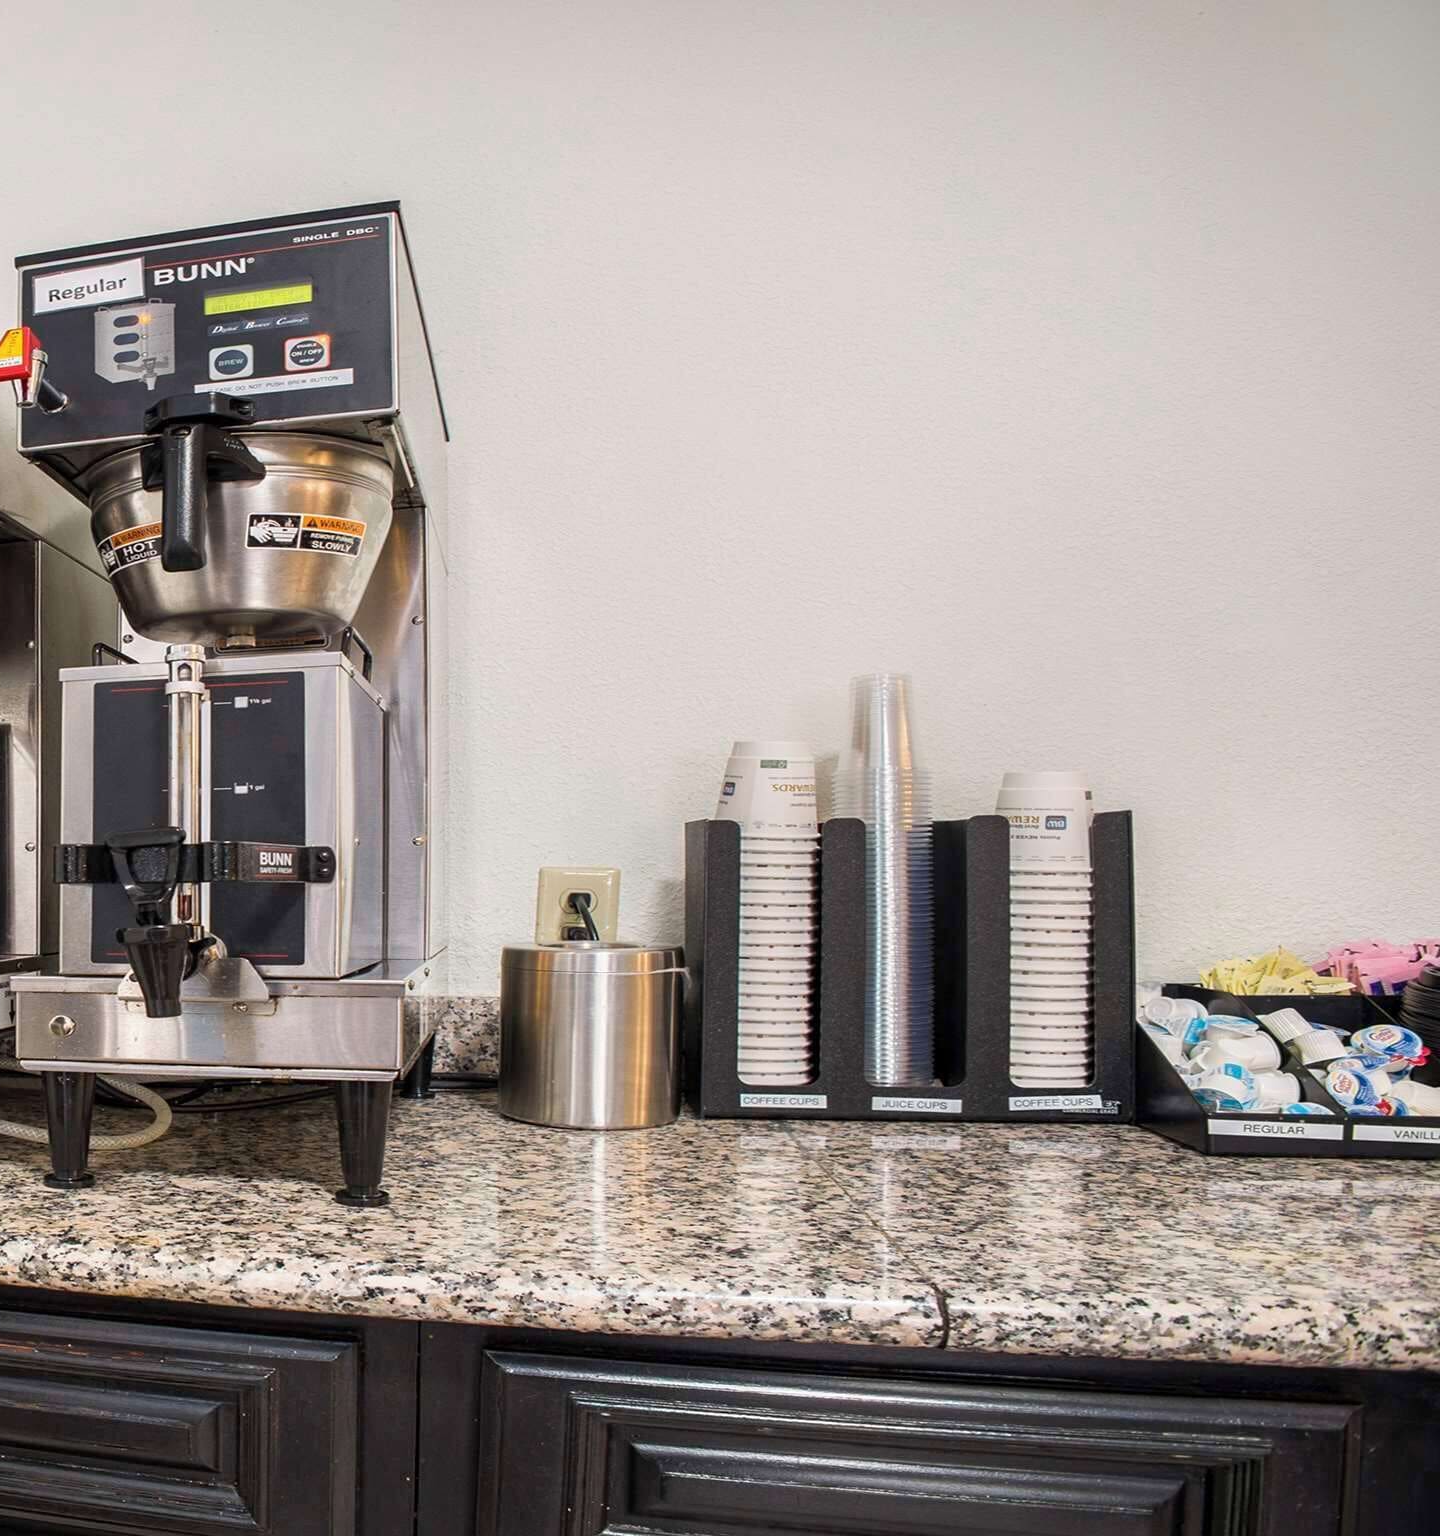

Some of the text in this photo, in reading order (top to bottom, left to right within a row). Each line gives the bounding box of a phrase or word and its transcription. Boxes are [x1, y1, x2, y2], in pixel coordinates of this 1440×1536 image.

[292, 231, 340, 243] SINGLE
[48, 276, 127, 302] Regular
[218, 358, 244, 367] BREW
[123, 540, 157, 556] HOT
[312, 540, 352, 552] SLOWLY
[126, 550, 158, 563] LIQUID
[260, 851, 293, 866] BUNN
[743, 1096, 820, 1106] COFFEE CUPS
[881, 1099, 948, 1110] JUICE CUPS
[1014, 1099, 1060, 1107] COFFEE
[1062, 1097, 1094, 1106] CUPS
[1243, 1123, 1306, 1135] REGULAR
